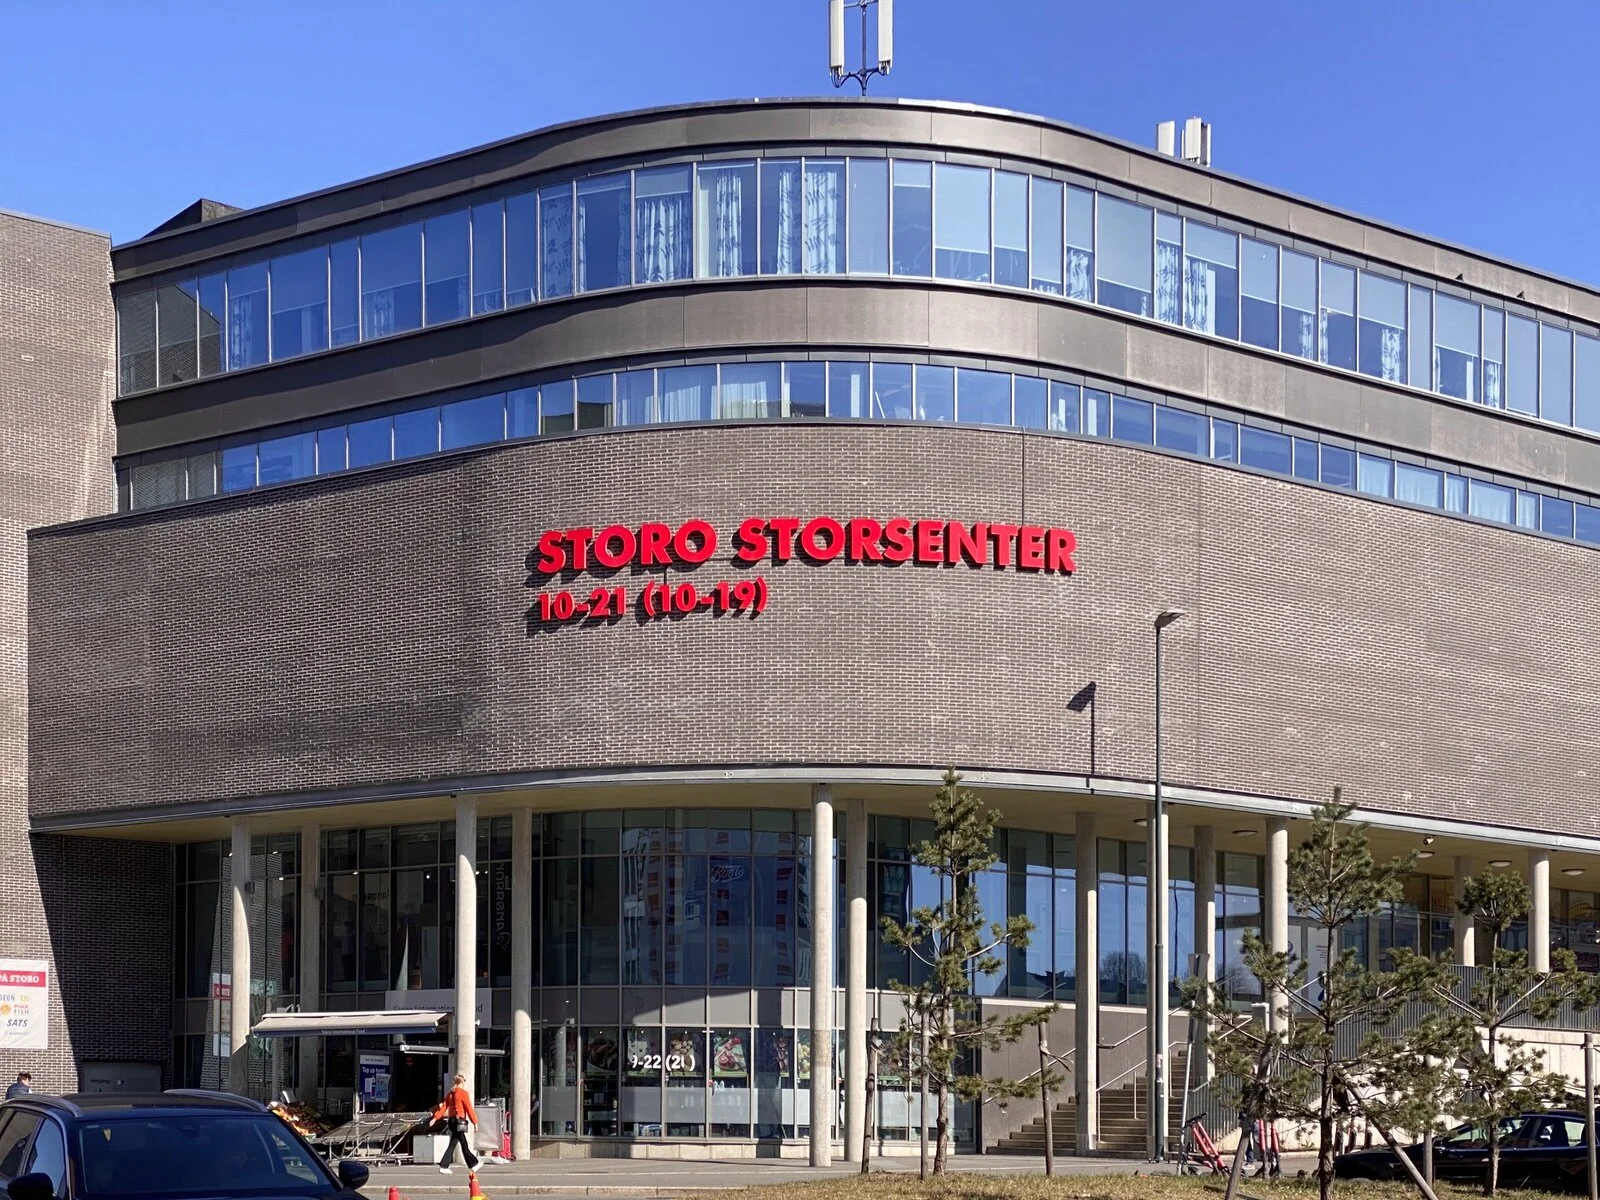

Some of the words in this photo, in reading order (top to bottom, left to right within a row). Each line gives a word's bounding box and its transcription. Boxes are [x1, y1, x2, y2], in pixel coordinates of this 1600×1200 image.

[536, 520, 717, 574] STORO
[732, 516, 1077, 574] STORSENTER
[538, 587, 626, 621] 10-21
[643, 577, 768, 617] (10-19)
[10, 975, 39, 983] STORO
[7, 1019, 28, 1027] SATS
